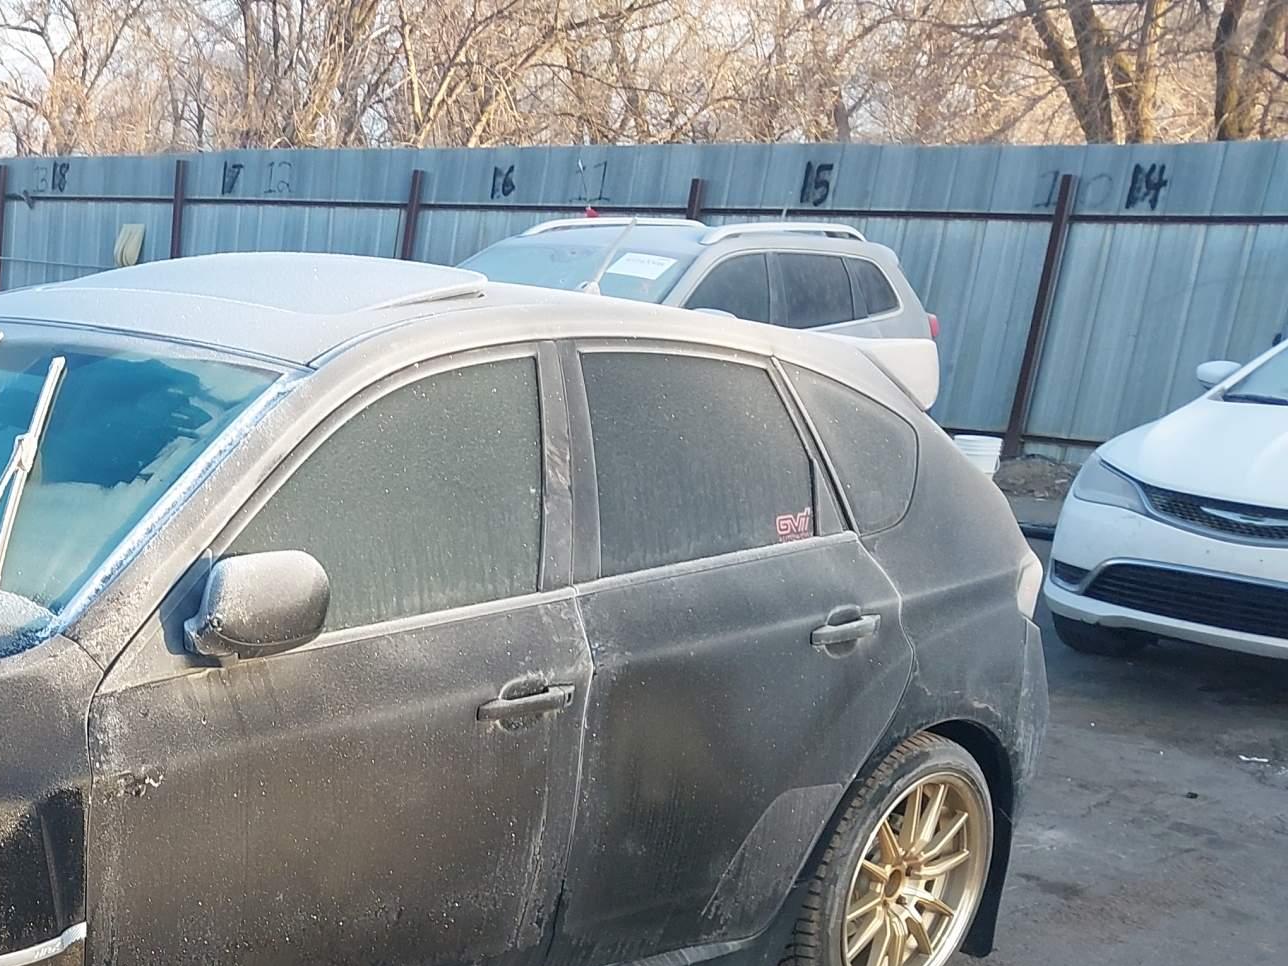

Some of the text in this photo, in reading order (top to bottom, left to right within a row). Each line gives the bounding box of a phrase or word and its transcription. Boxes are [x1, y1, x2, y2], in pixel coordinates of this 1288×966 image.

[51, 160, 70, 193] 18
[263, 161, 292, 193] 12
[490, 165, 516, 200] 16
[799, 161, 834, 207] 15
[1125, 163, 1168, 211] 14
